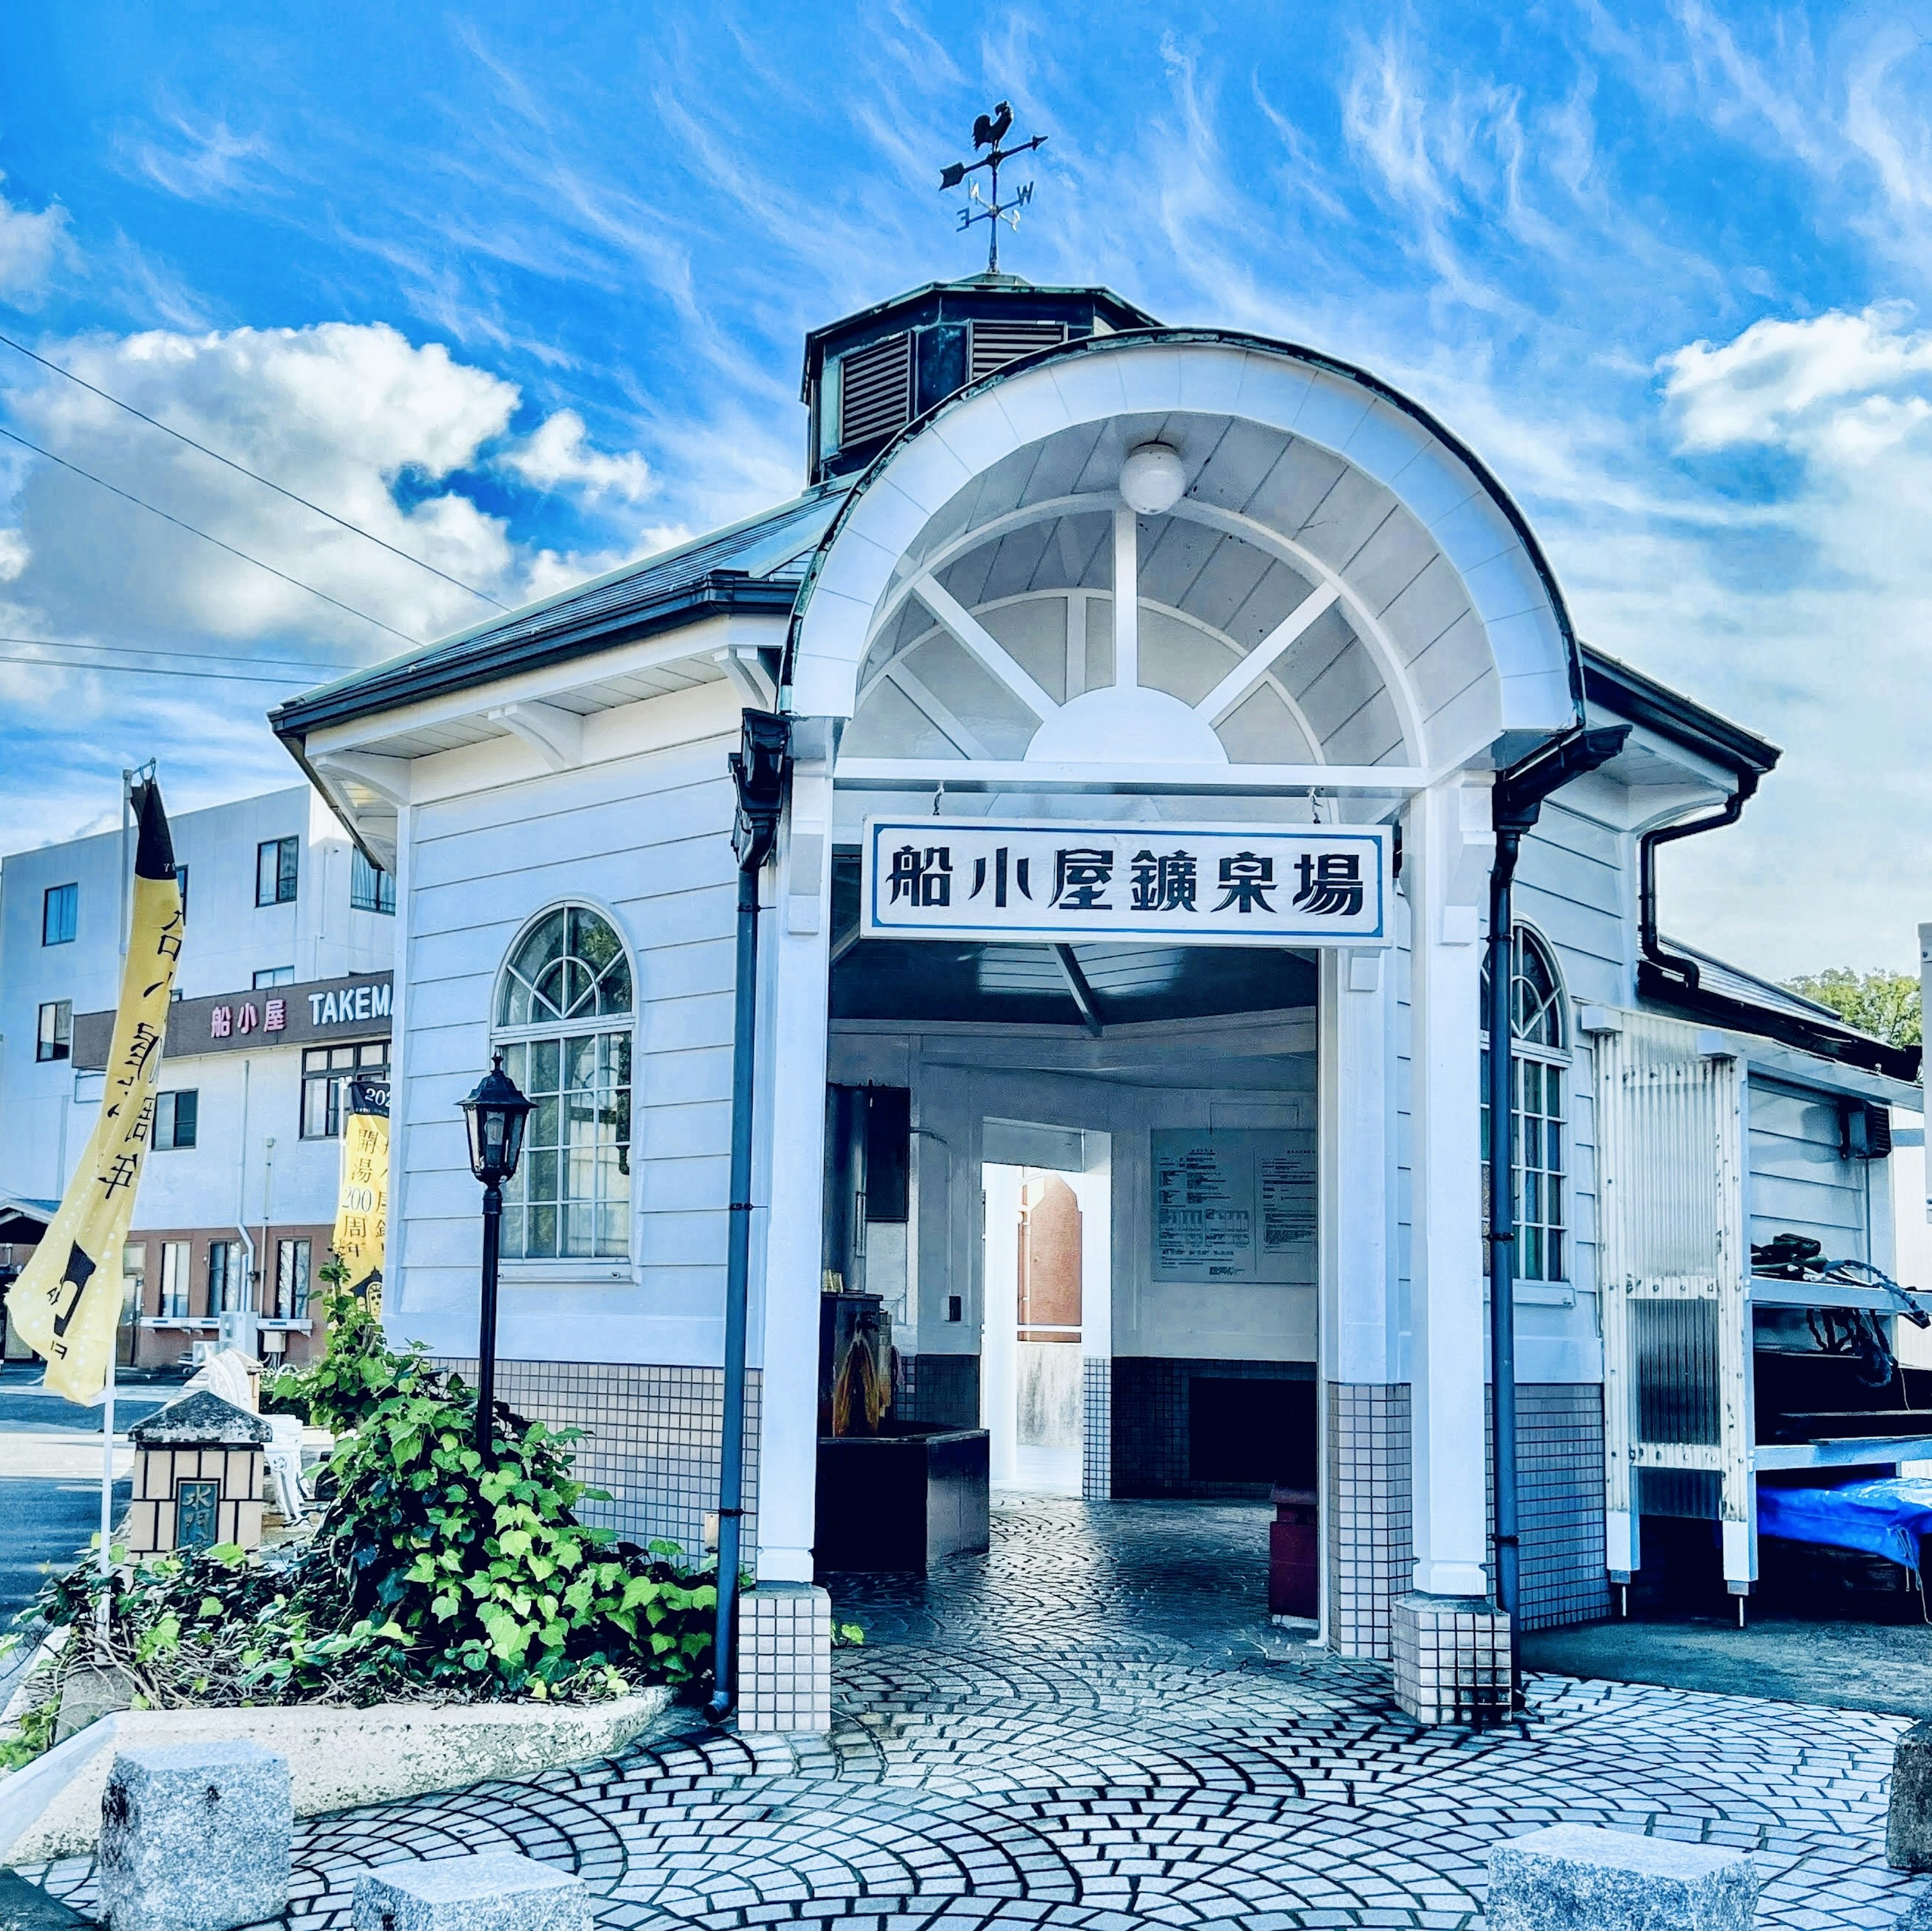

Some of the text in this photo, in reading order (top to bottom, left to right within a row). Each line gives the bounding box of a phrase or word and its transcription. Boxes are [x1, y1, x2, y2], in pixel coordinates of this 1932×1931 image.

[1016, 181, 1034, 207] W
[211, 998, 286, 1038] 船小屋
[308, 983, 393, 1026] TAKEM
